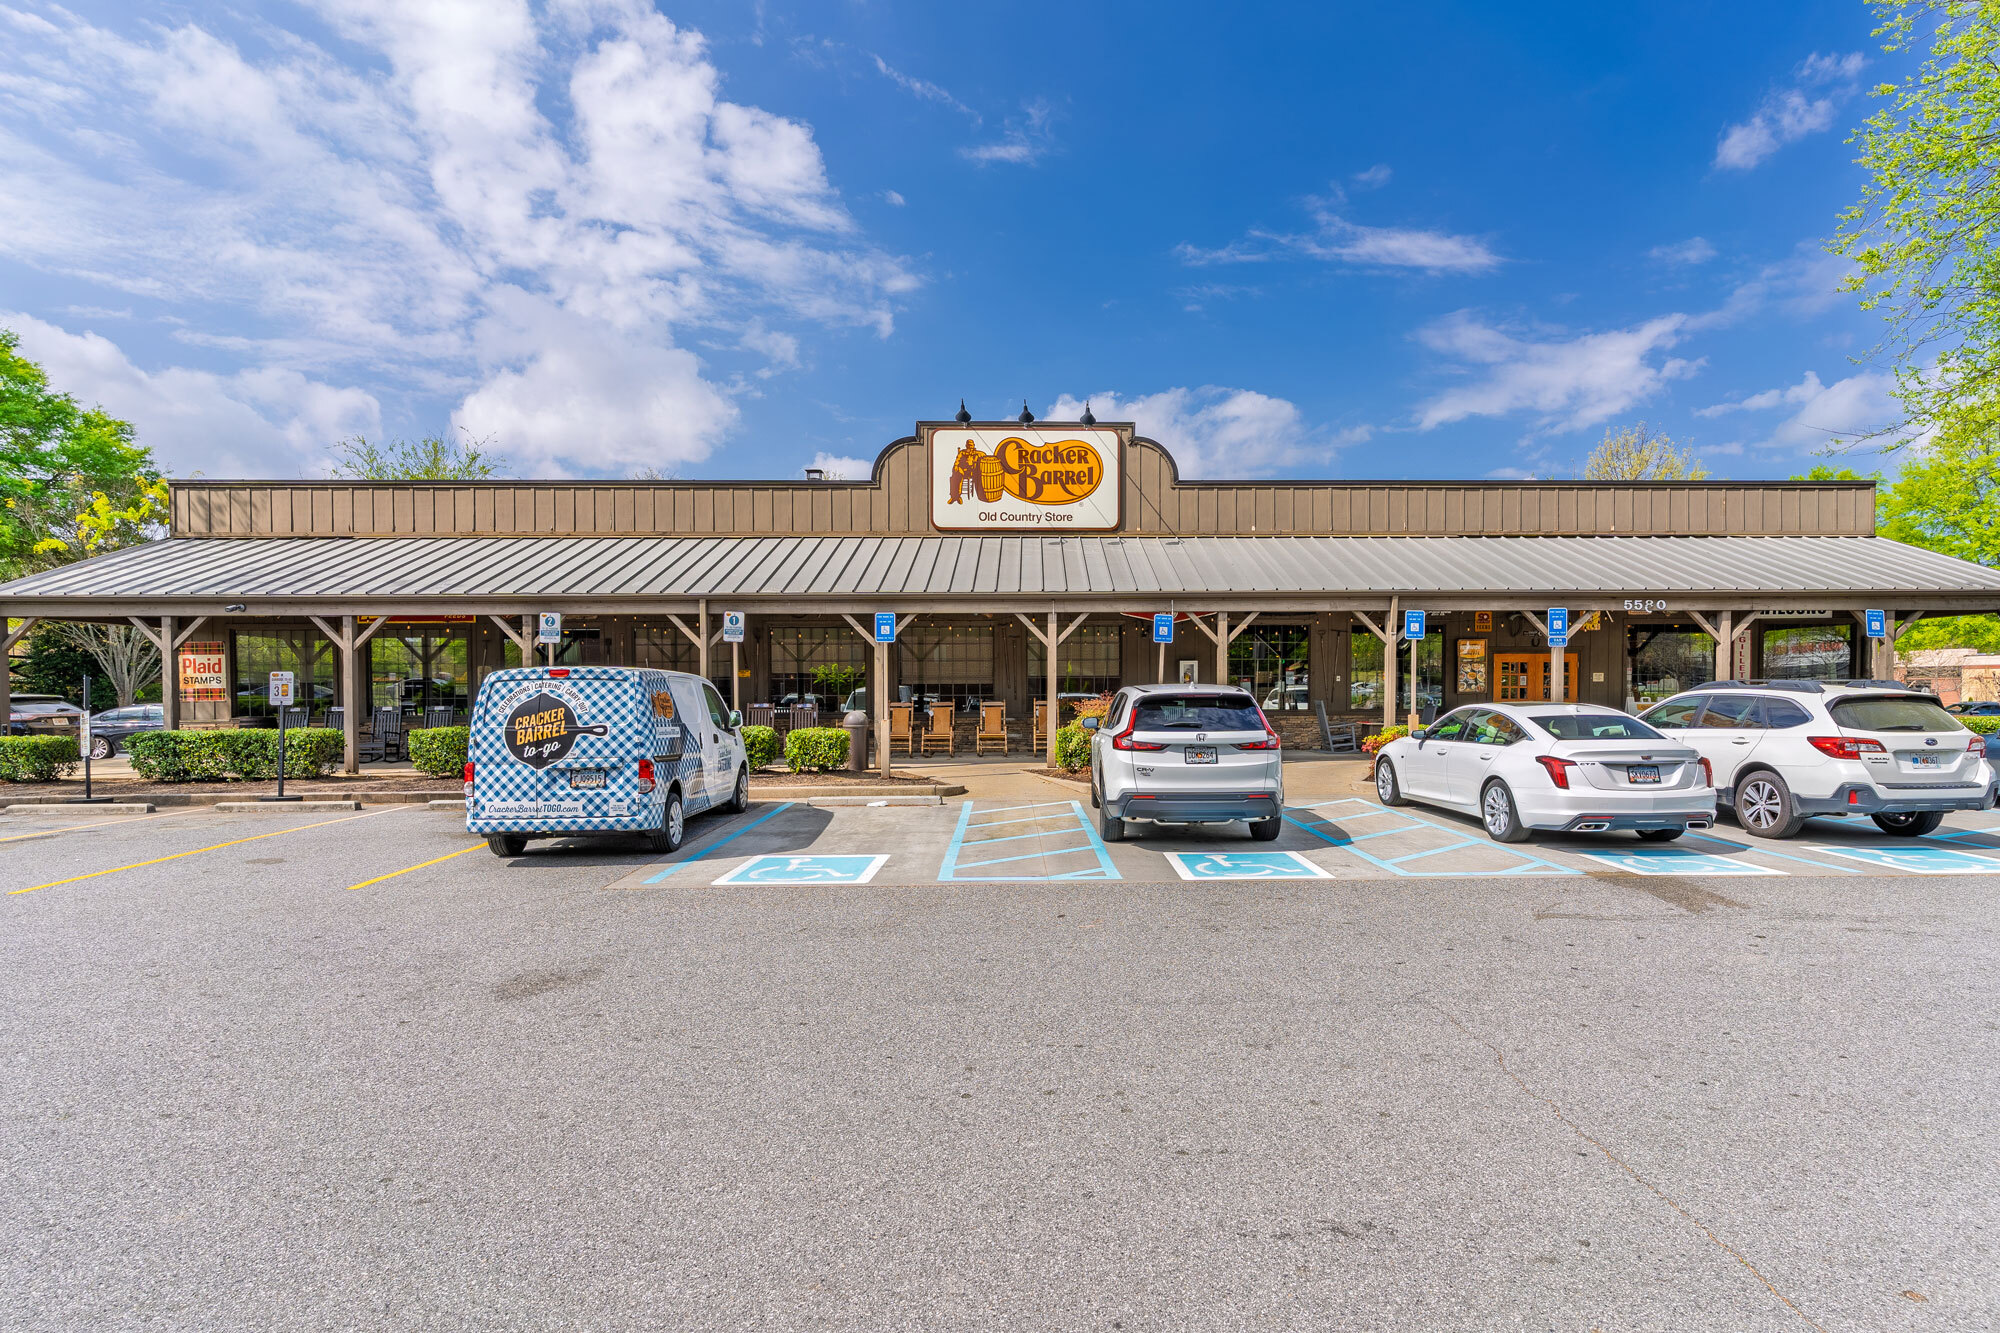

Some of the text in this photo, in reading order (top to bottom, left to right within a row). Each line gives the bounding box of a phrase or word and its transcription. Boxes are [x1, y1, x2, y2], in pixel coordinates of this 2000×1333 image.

[1000, 440, 1089, 474] Cracker
[1018, 464, 1093, 500] Barrel
[978, 512, 1073, 524] Old Country Store
[547, 617, 553, 626] 2
[182, 658, 222, 674] Plaid
[183, 676, 222, 685] STAMPS
[274, 685, 280, 697] 3
[499, 682, 588, 714] CELEBRATIONS CATERING CARRY-OUT
[515, 707, 565, 730] CRACKER
[516, 720, 568, 746] BARREL
[523, 741, 562, 758] to-go
[488, 804, 579, 814] CrackerBarrelTOGO.com
